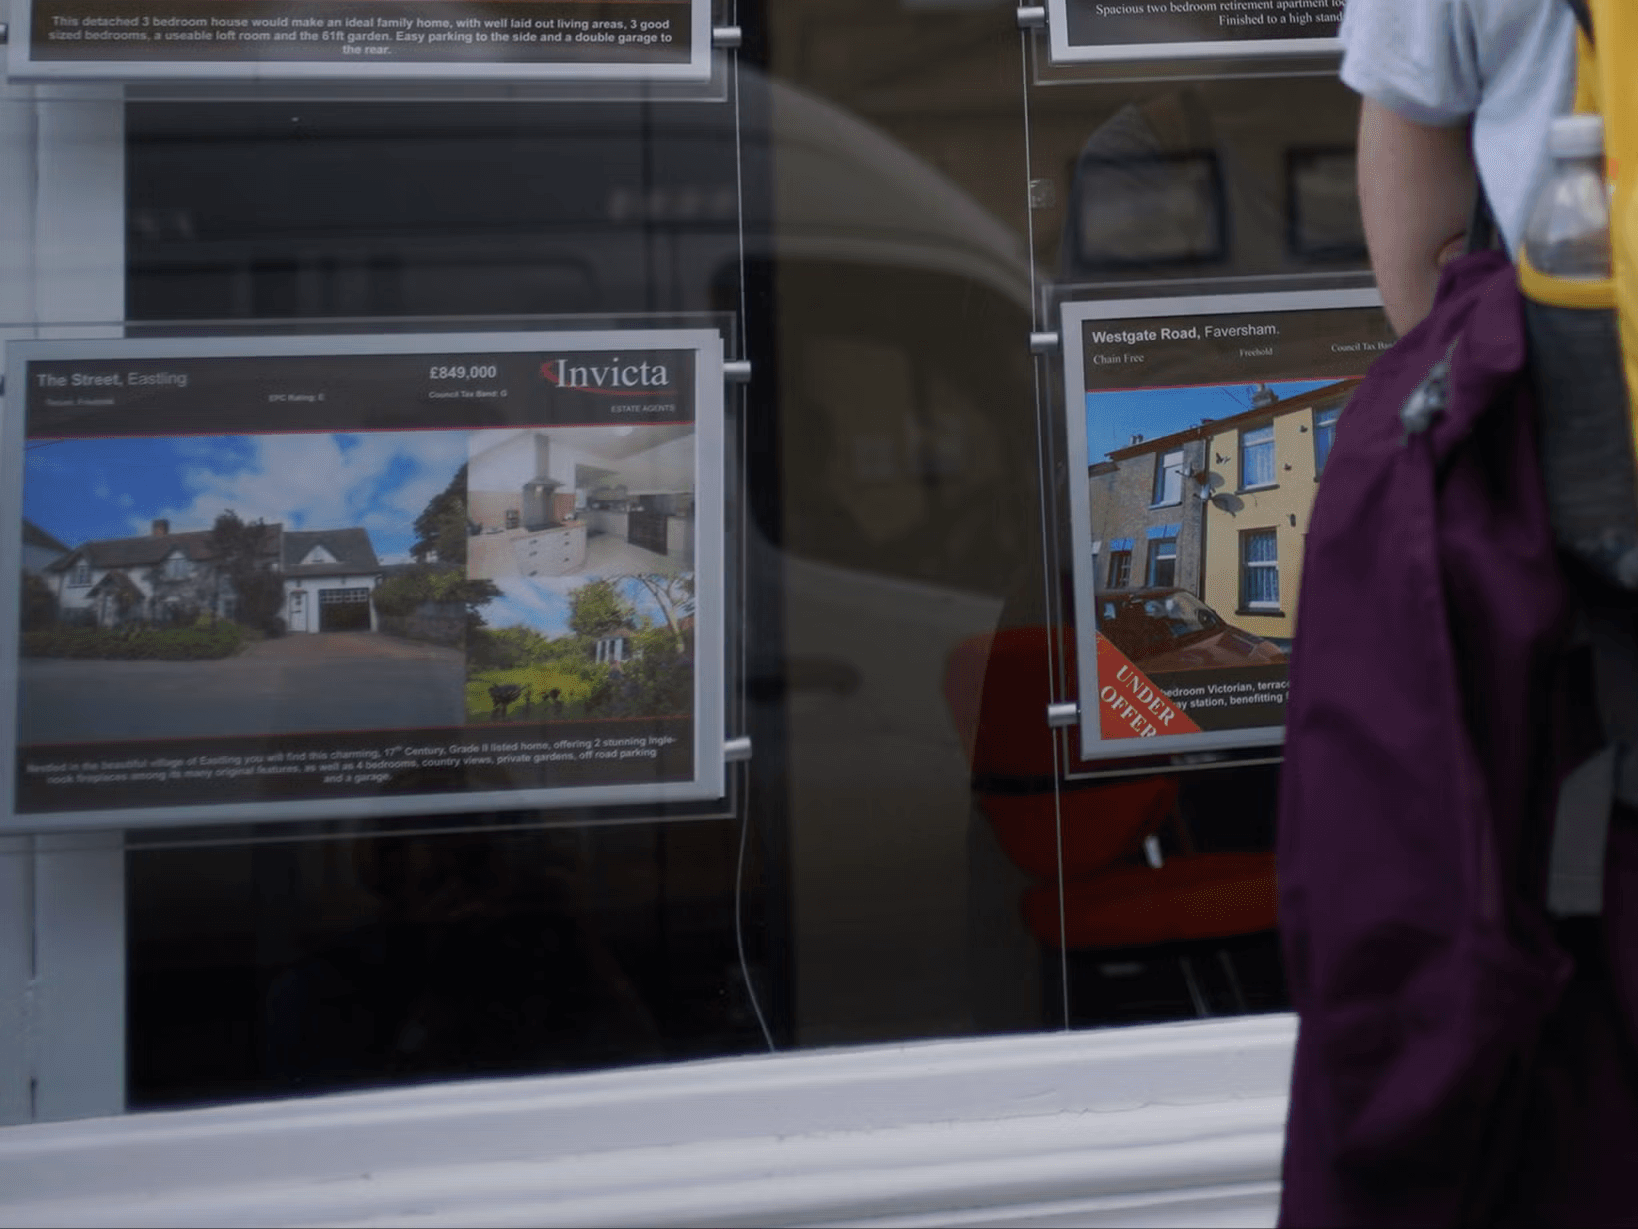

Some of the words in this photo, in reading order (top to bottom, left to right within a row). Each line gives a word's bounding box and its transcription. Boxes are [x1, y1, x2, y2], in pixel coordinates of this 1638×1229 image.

[1095, 3, 1144, 17] Spacious
[1146, 4, 1167, 13] two
[1169, 1, 1217, 12] bedroom
[1219, 0, 1273, 10] retirement
[51, 15, 79, 26] This
[81, 16, 139, 26] detached
[141, 16, 149, 26] 3
[152, 16, 207, 26] bedroom
[210, 17, 248, 27] house
[251, 17, 288, 27] would
[291, 17, 324, 27] make
[326, 19, 342, 27] an
[345, 17, 374, 27] ideal
[377, 17, 413, 29] family
[416, 17, 453, 28] home,
[455, 17, 481, 28] with
[483, 18, 507, 28] well
[510, 18, 532, 28] laid
[534, 19, 554, 28] out
[557, 19, 589, 31] living
[591, 20, 627, 29] areas,
[630, 19, 637, 29] 3
[639, 19, 669, 31] good
[1218, 13, 1264, 25] Finished
[1266, 15, 1277, 24] to
[1280, 15, 1286, 23] a
[1288, 12, 1312, 26] high
[1315, 11, 1343, 24] stand
[342, 44, 362, 54] the
[364, 46, 391, 54] rear.
[1091, 329, 1157, 344] Westgate
[1160, 326, 1200, 339] Road,
[1204, 323, 1279, 337] Faversham.
[1239, 346, 1273, 358] Freehold
[1330, 342, 1360, 352] Council
[1362, 342, 1376, 350] Tax
[1092, 354, 1121, 364] Chain
[1123, 353, 1144, 363] Free
[36, 373, 67, 386] The
[127, 371, 188, 387] Eastling
[429, 365, 497, 382] £849,000
[556, 357, 669, 388] Invicta
[610, 404, 641, 413] ESTATE
[642, 403, 675, 412] AGENTS
[1116, 665, 1176, 727] UNDER
[1207, 682, 1255, 694] Victorian,
[1190, 696, 1227, 708] station,
[1229, 692, 1283, 705] benefitting
[1100, 685, 1157, 738] OFFER
